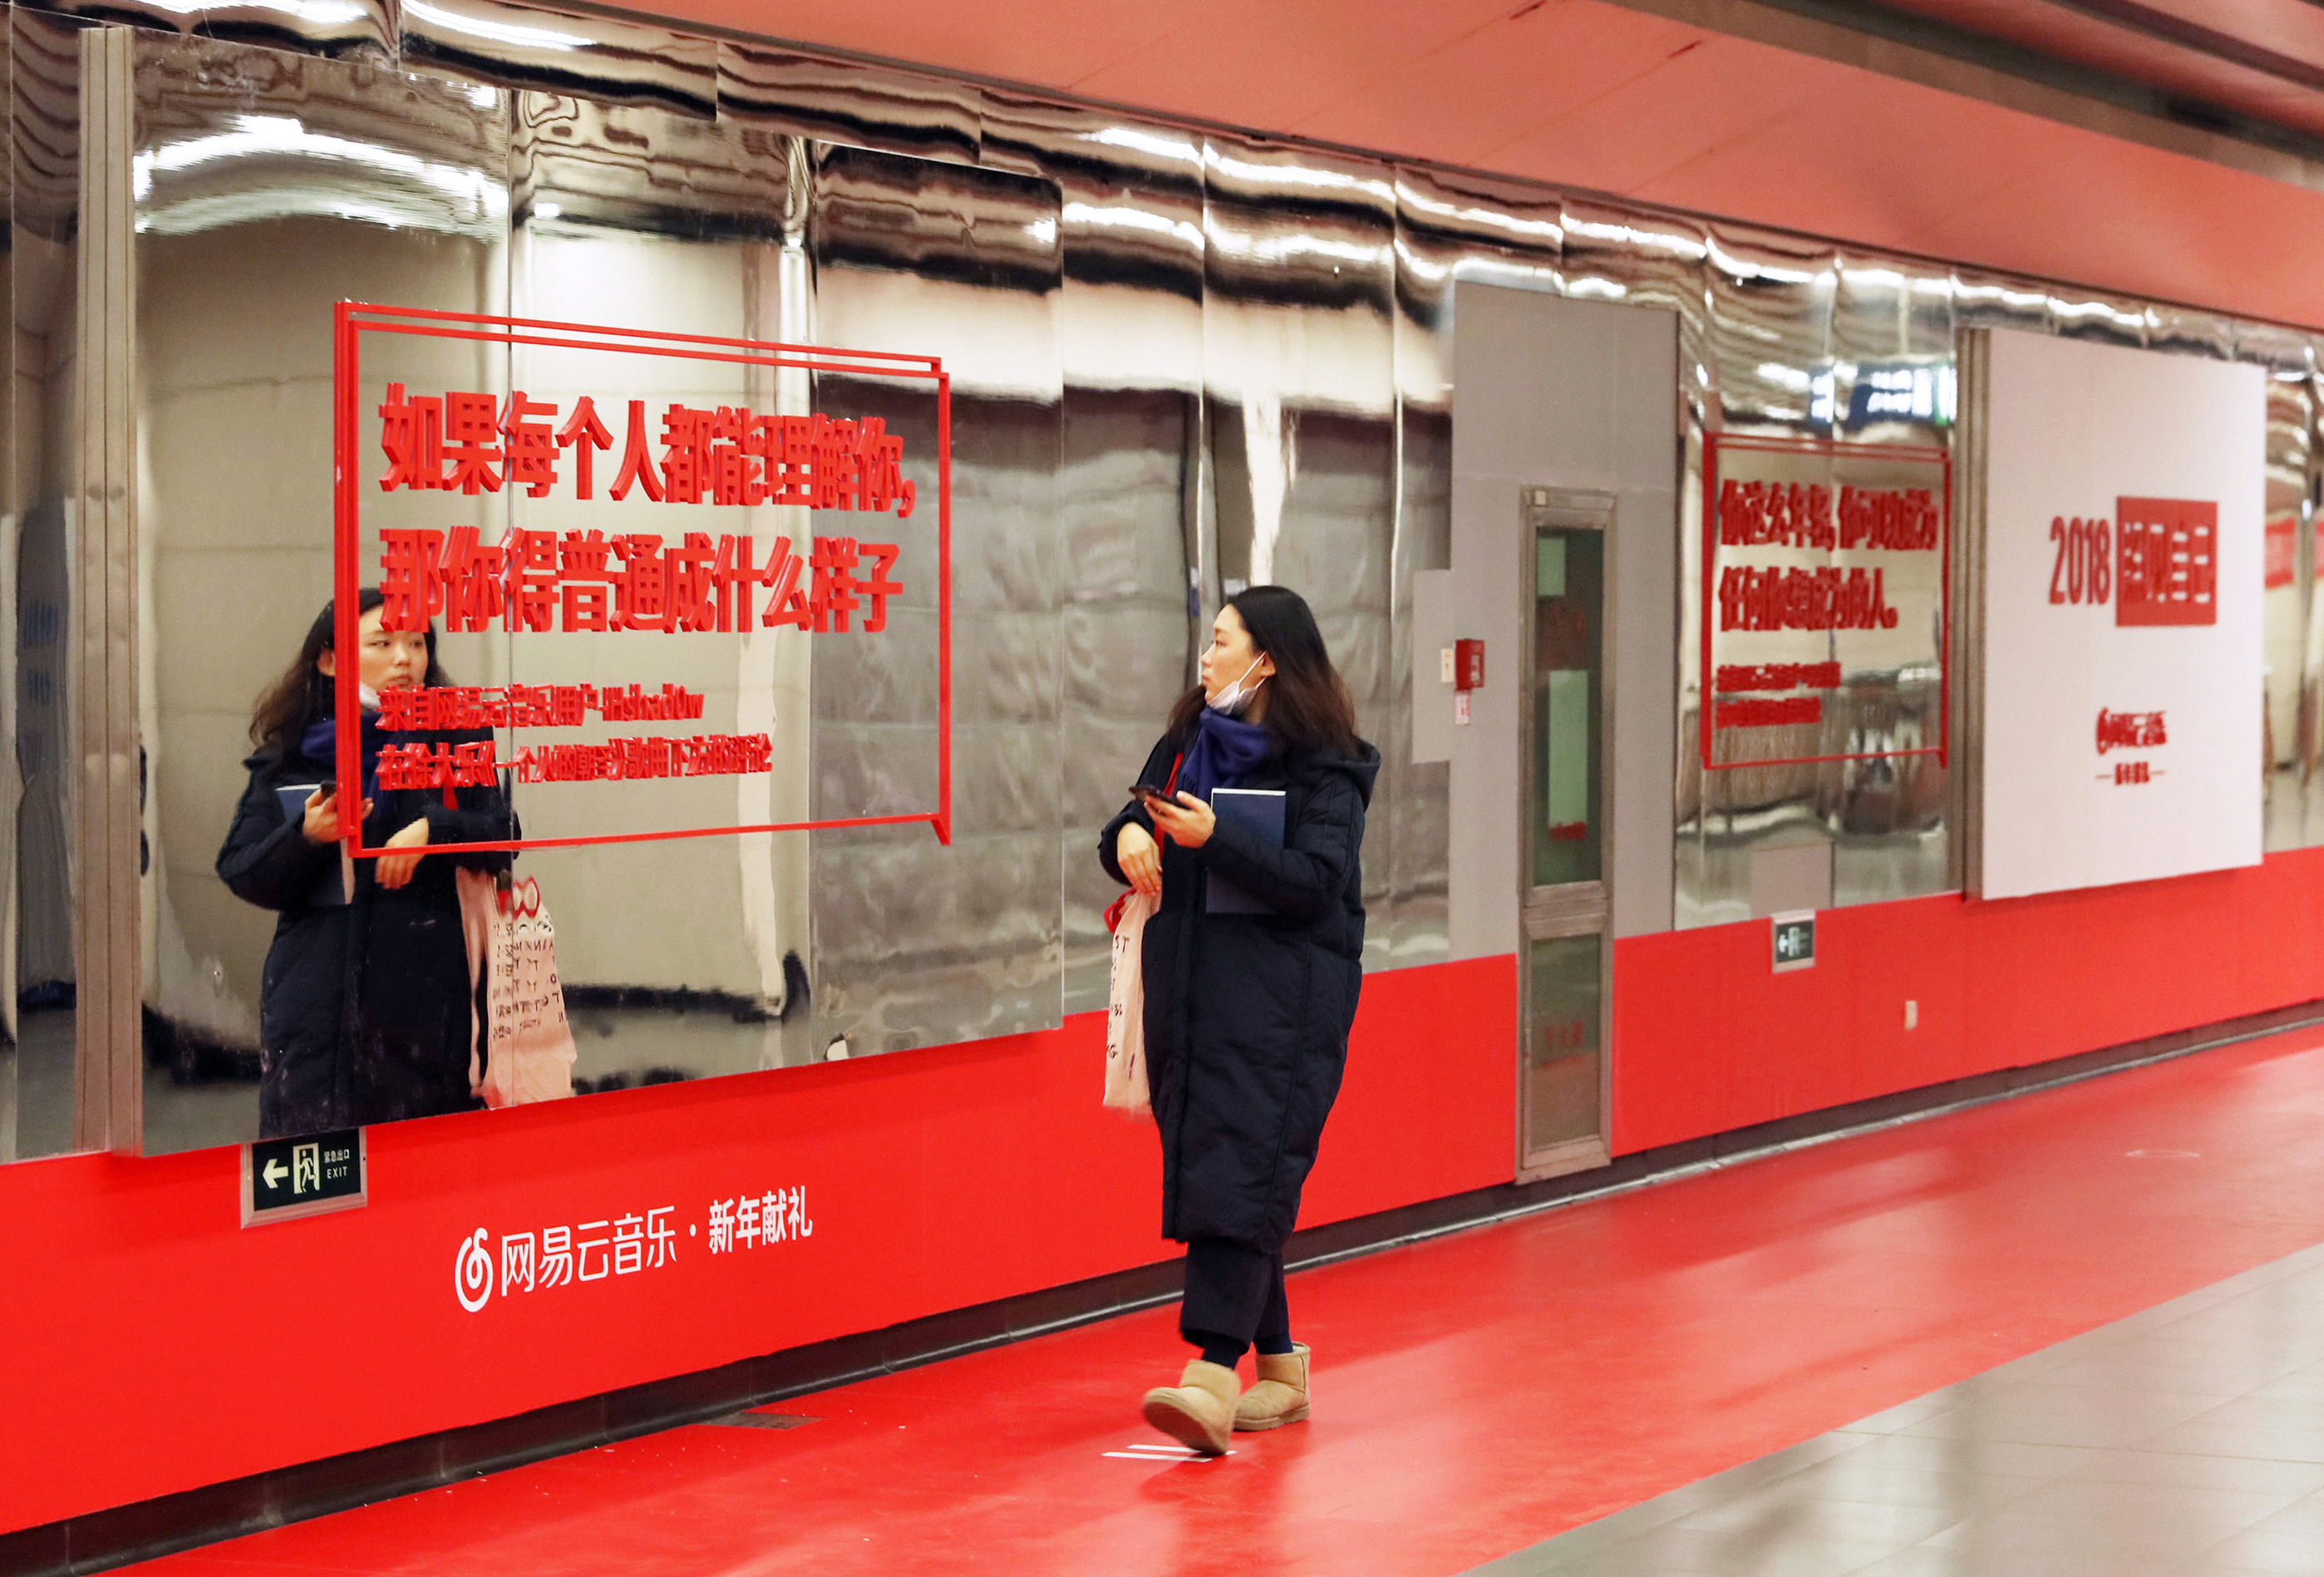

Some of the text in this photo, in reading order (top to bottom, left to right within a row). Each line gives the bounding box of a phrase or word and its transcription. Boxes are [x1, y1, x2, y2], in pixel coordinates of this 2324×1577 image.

[379, 382, 916, 518] 如果每个人都能理解你，
[380, 525, 904, 633] 那你得普通成什么样子
[2050, 516, 2110, 604] 2018
[327, 1166, 347, 1179] EXIT
